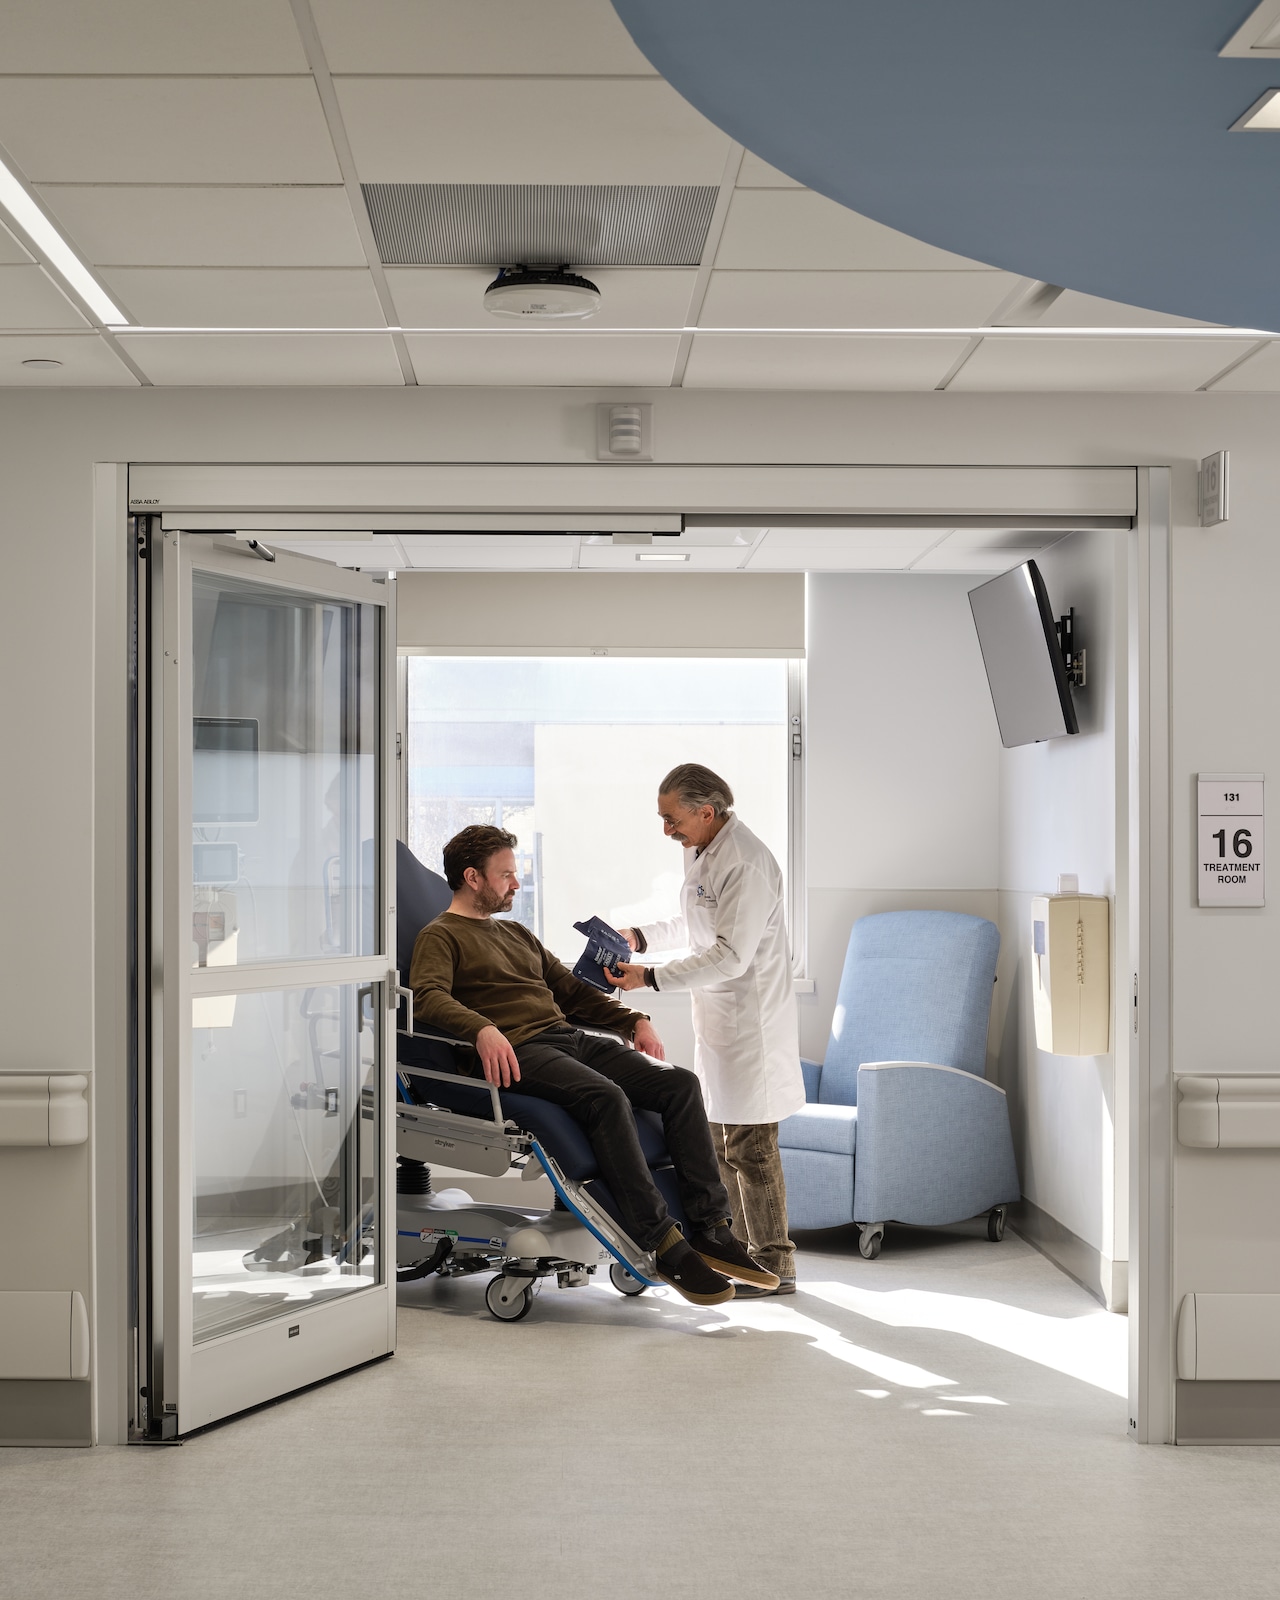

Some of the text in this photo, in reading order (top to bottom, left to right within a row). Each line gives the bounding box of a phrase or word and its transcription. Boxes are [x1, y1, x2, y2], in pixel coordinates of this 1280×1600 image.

[1205, 461, 1217, 492] 16
[1223, 793, 1240, 801] 131
[1212, 828, 1253, 858] 16
[1203, 863, 1261, 872] TREATMENT
[1217, 875, 1247, 884] ROOM
